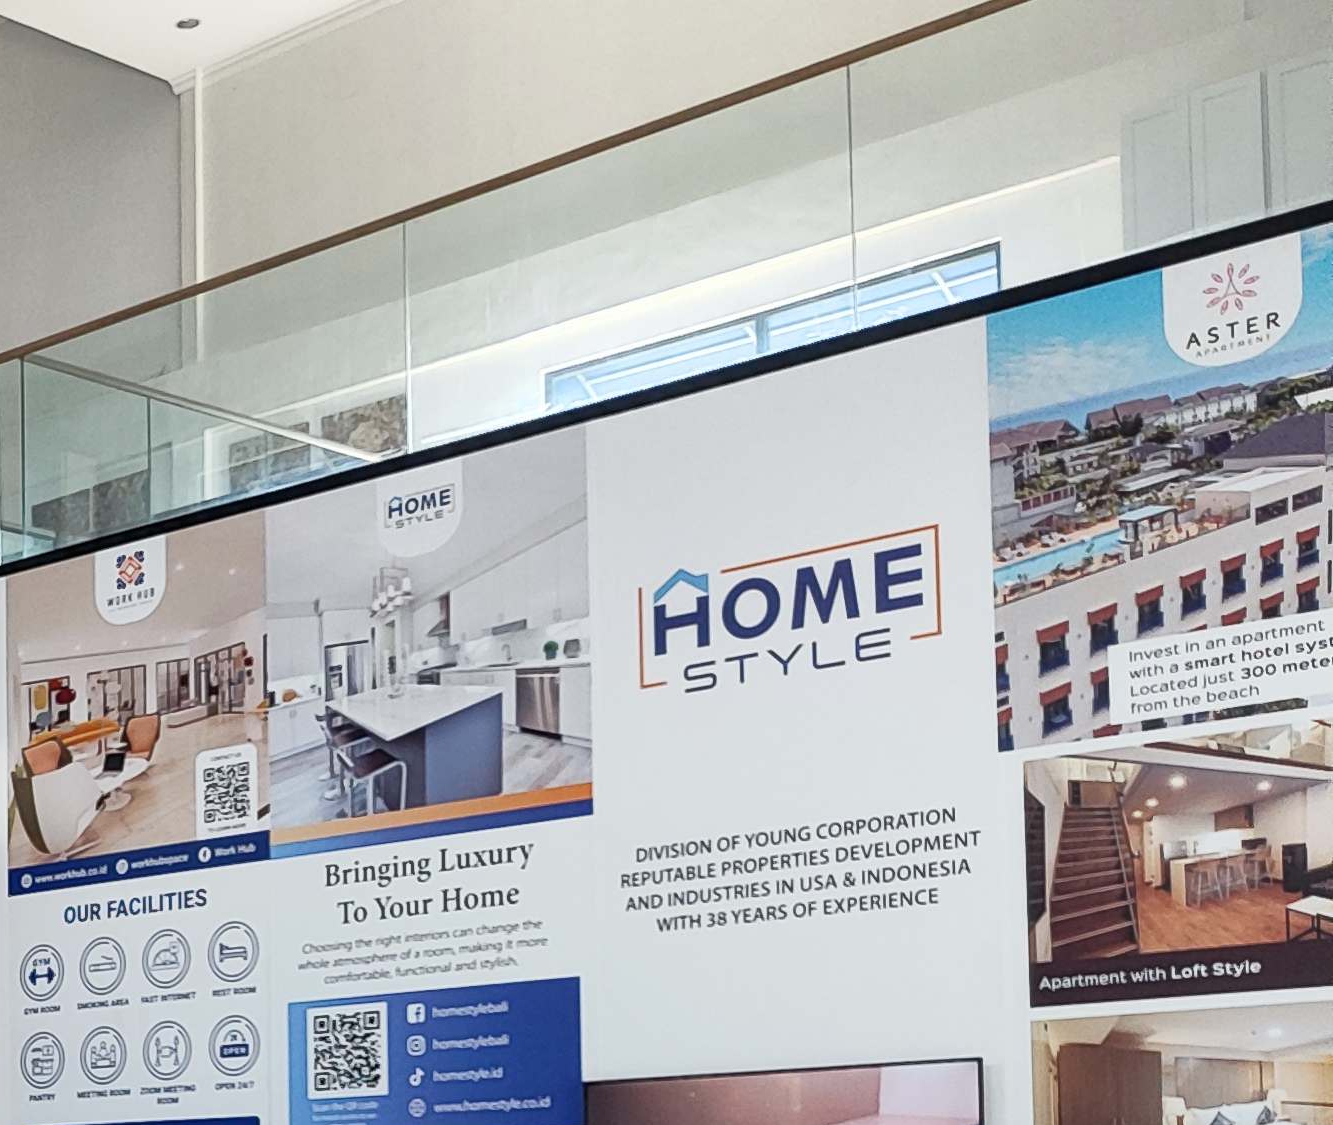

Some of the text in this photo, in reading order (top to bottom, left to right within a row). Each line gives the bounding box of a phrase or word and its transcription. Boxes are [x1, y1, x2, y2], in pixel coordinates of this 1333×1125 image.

[1186, 312, 1280, 350] ASTER
[1196, 334, 1270, 357] APARTMENT
[389, 489, 451, 519] HOME
[396, 510, 443, 529] STYLE
[654, 544, 923, 656] HOME
[1129, 620, 1325, 663] Invest in an apartment
[683, 628, 891, 693] STYLE
[1129, 643, 1289, 679] with a smart hotel
[1130, 664, 1276, 697] Located just 300
[1131, 685, 1259, 714] from the beach
[636, 807, 956, 863] DIVISION OF YOUNG CORPORATION
[35, 865, 107, 884] www.workhub.co.id
[325, 842, 534, 888] Bringing Luxury
[621, 831, 981, 888] REPUTABLE PROPERTIES DEVELOPMENT
[626, 859, 971, 911] AND INDUSTRIES IN USA & INDONESIA
[63, 889, 207, 924] OUR FACILITIES
[337, 887, 520, 925] To Your Home
[656, 888, 939, 932] WITH 38 YEARS OF EXPERIENCE
[297, 959, 329, 970] whole
[333, 953, 397, 967] atmosphere
[400, 949, 412, 960] of
[458, 942, 503, 954] making
[505, 940, 513, 949] it
[516, 937, 548, 948] more
[302, 941, 352, 955] Choosing
[355, 940, 372, 948] the
[376, 935, 402, 948] right
[453, 928, 474, 938] can
[476, 923, 519, 936] change
[523, 920, 543, 930] the
[395, 962, 451, 977] functional
[455, 960, 476, 970] and
[1039, 960, 1262, 991] Apartment with Loft Style
[434, 1096, 551, 1114] www.homestyle.co.id
